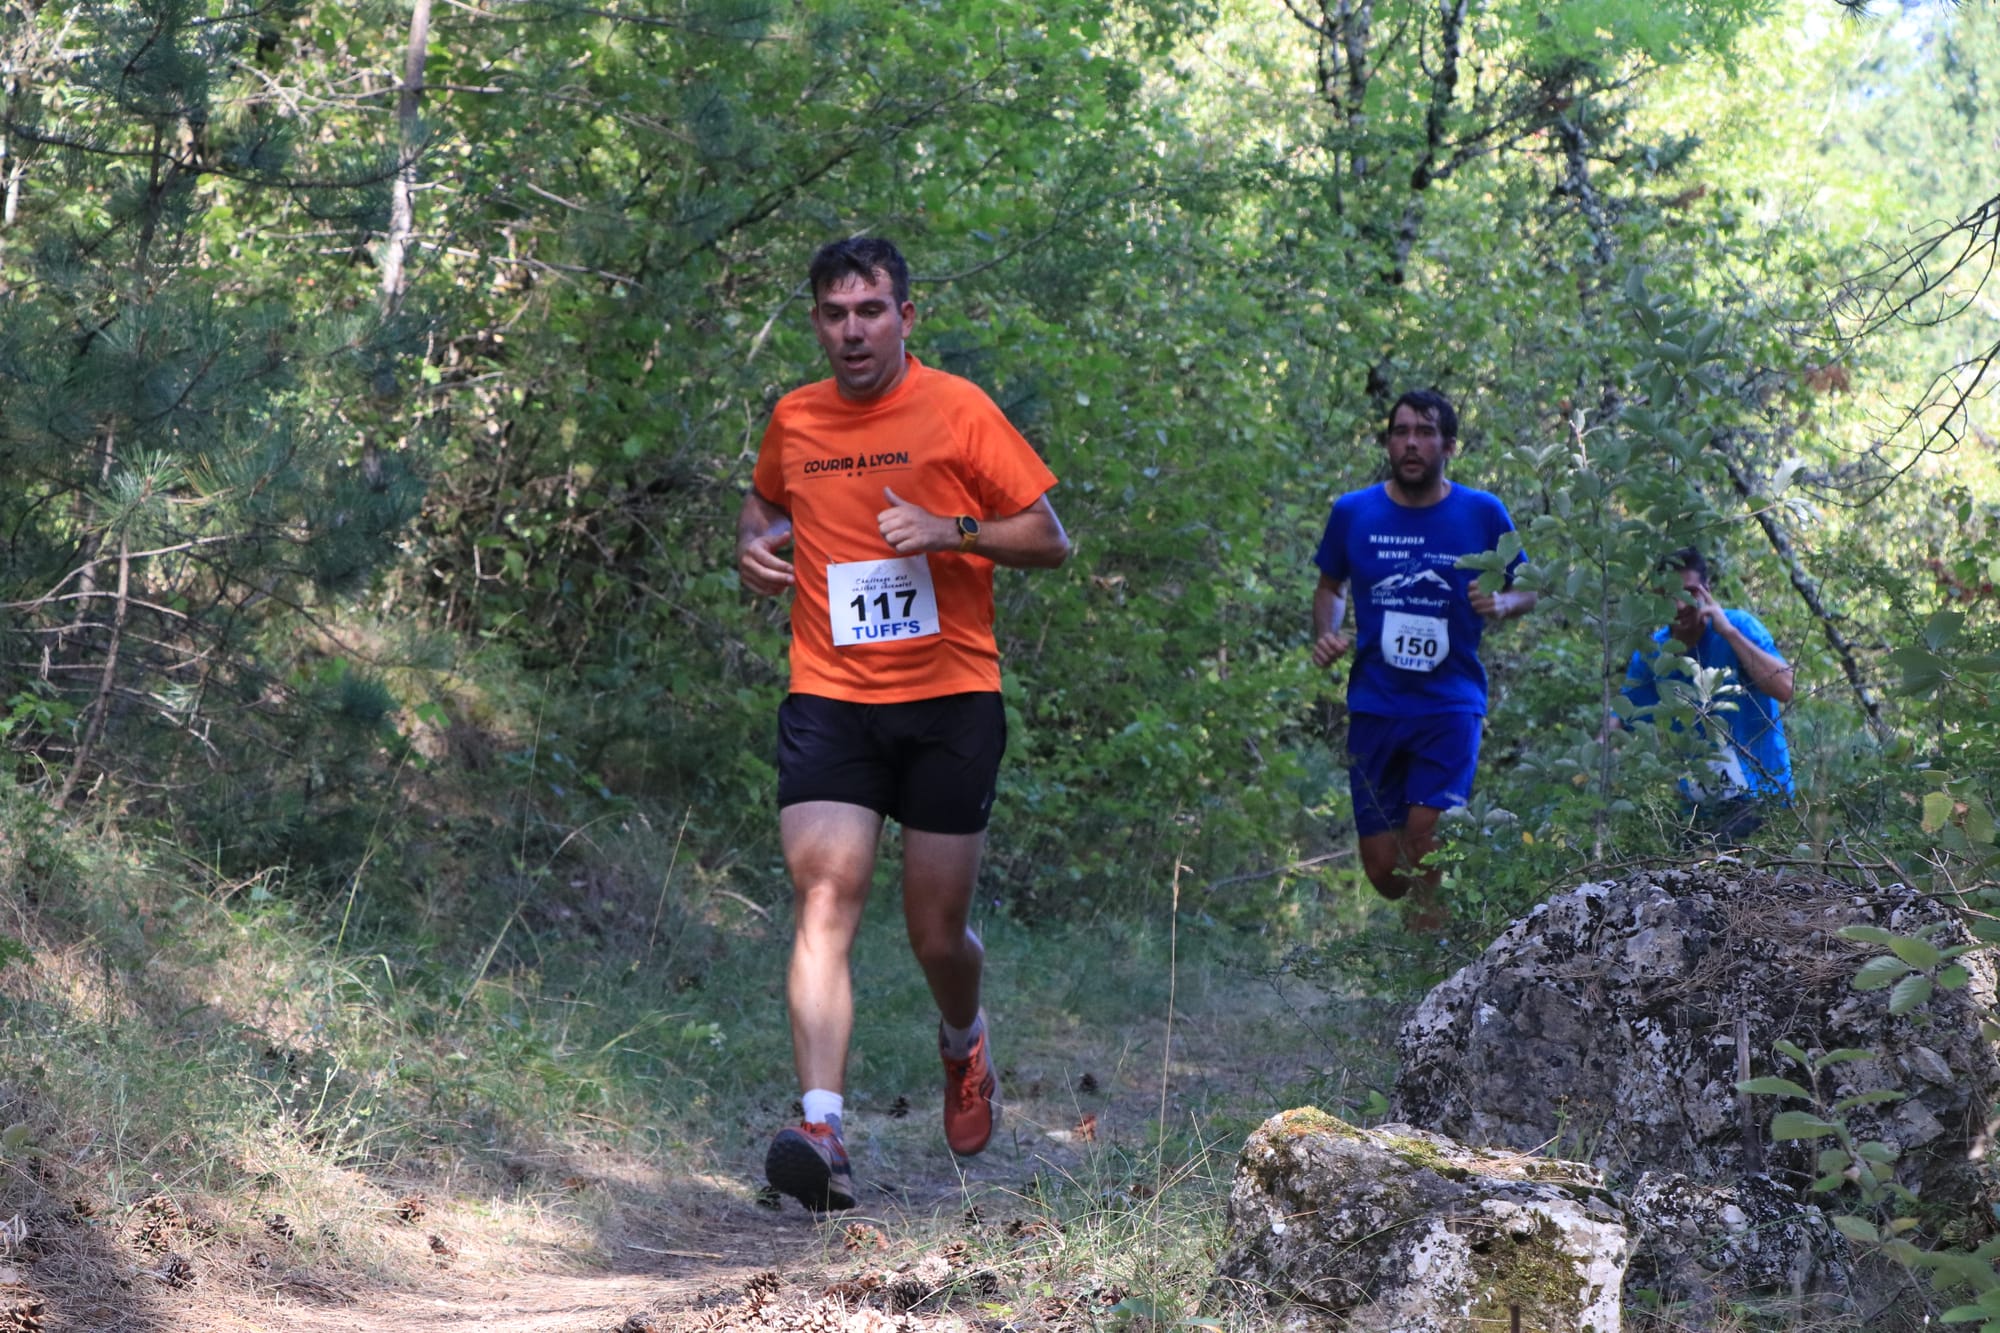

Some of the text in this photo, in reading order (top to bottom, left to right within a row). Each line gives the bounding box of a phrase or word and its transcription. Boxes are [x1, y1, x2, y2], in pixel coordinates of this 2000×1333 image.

[804, 452, 908, 474] COURIR À LYON
[1369, 535, 1425, 545] MARVEJOLS
[1378, 550, 1410, 560] MENDE
[851, 590, 917, 622] 117
[852, 621, 921, 640] TUFF'S
[1395, 636, 1438, 657] 150
[1393, 656, 1435, 668] TUFF'S
